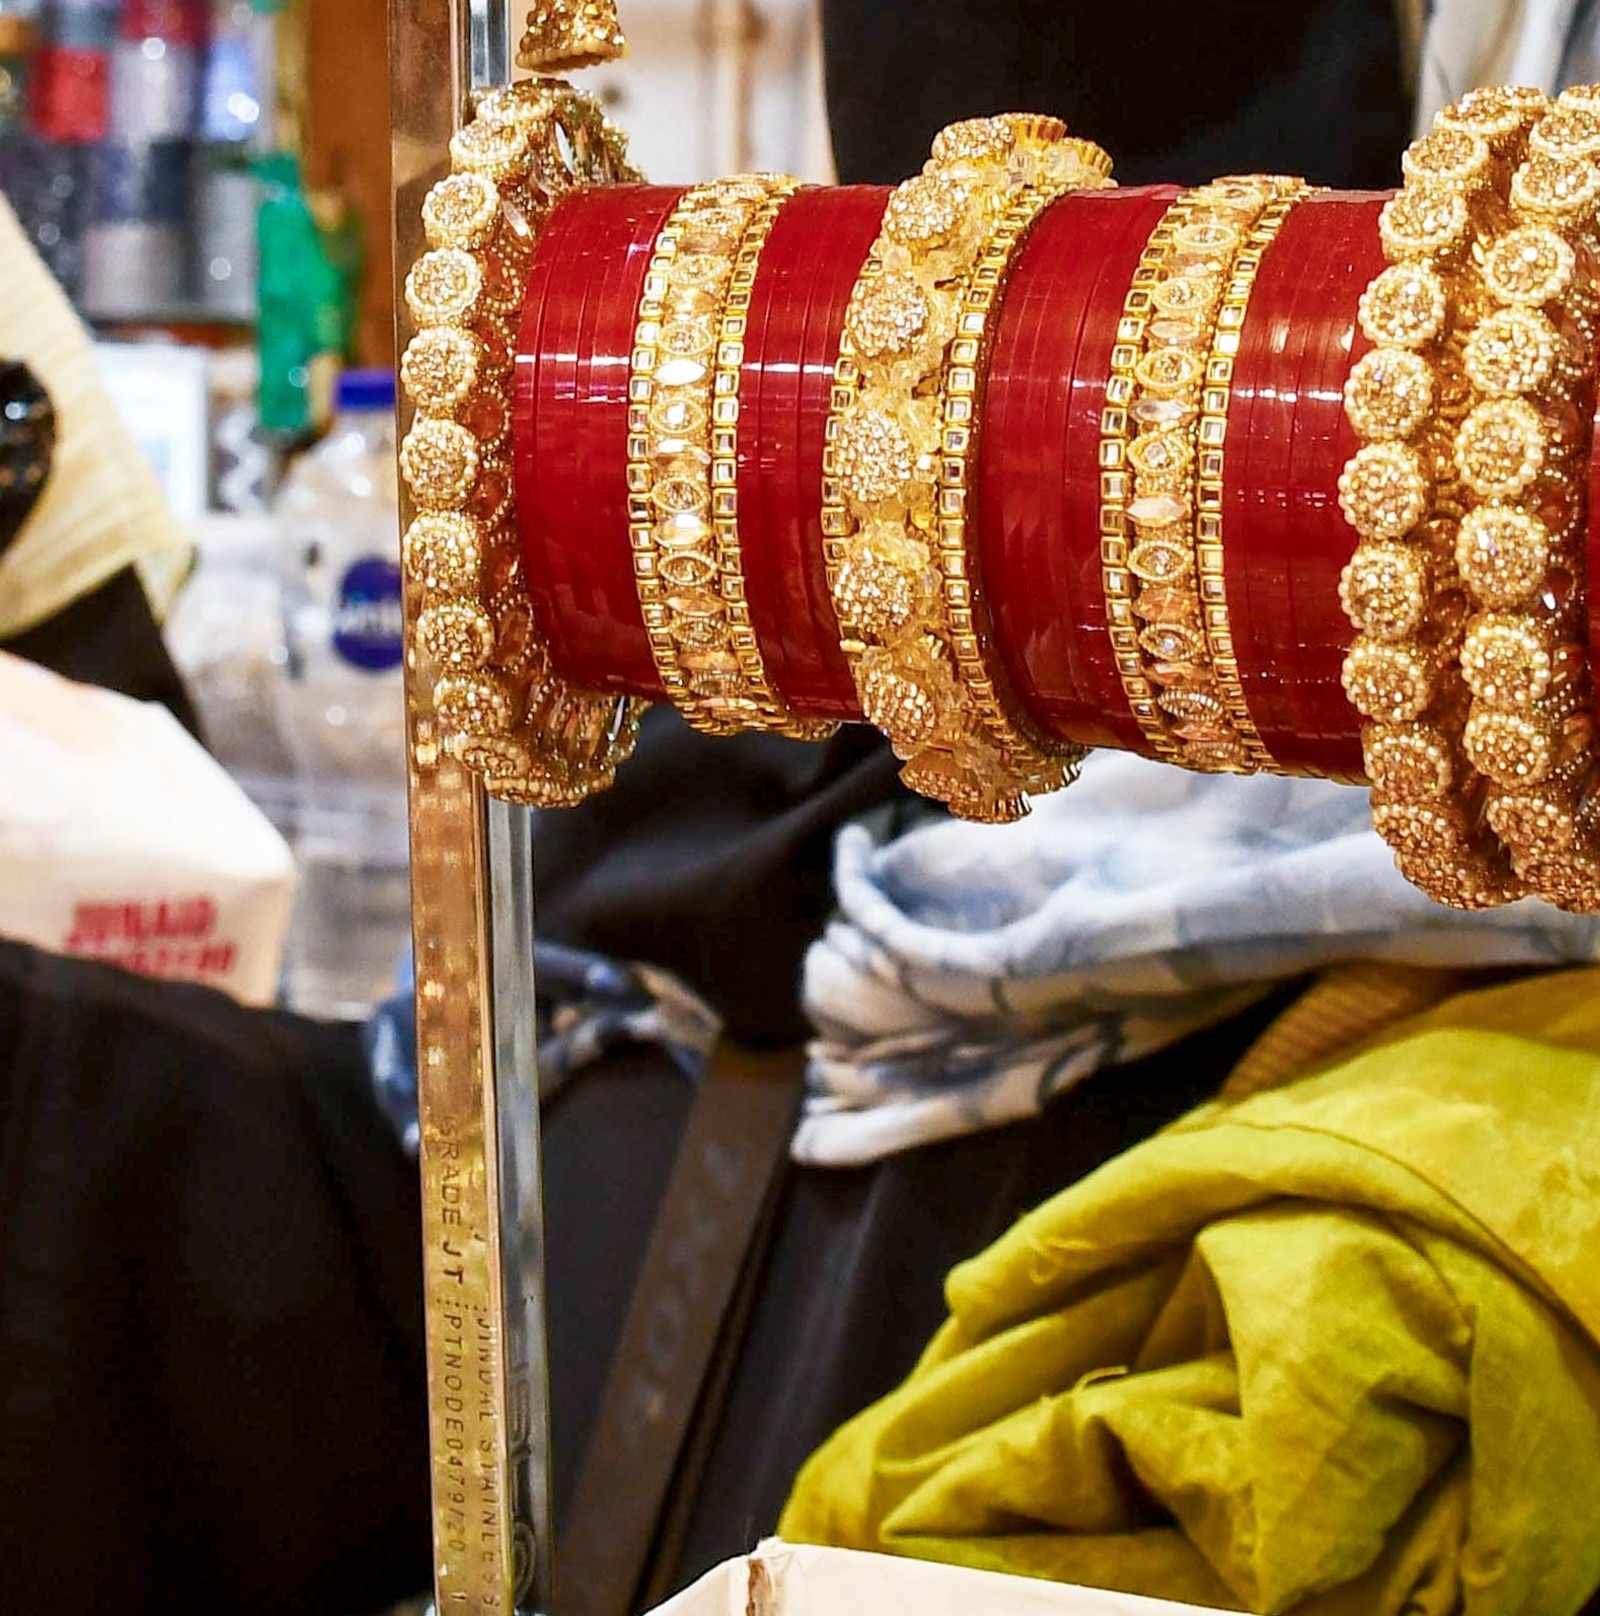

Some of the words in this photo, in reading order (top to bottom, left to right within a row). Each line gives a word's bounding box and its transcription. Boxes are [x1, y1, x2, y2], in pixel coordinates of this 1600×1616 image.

[440, 1115, 462, 1227] GRADE
[477, 1315, 496, 1422] JINDAL
[443, 1313, 468, 1603] PTNODE0479/201
[479, 1439, 500, 1607] STAINLESS
